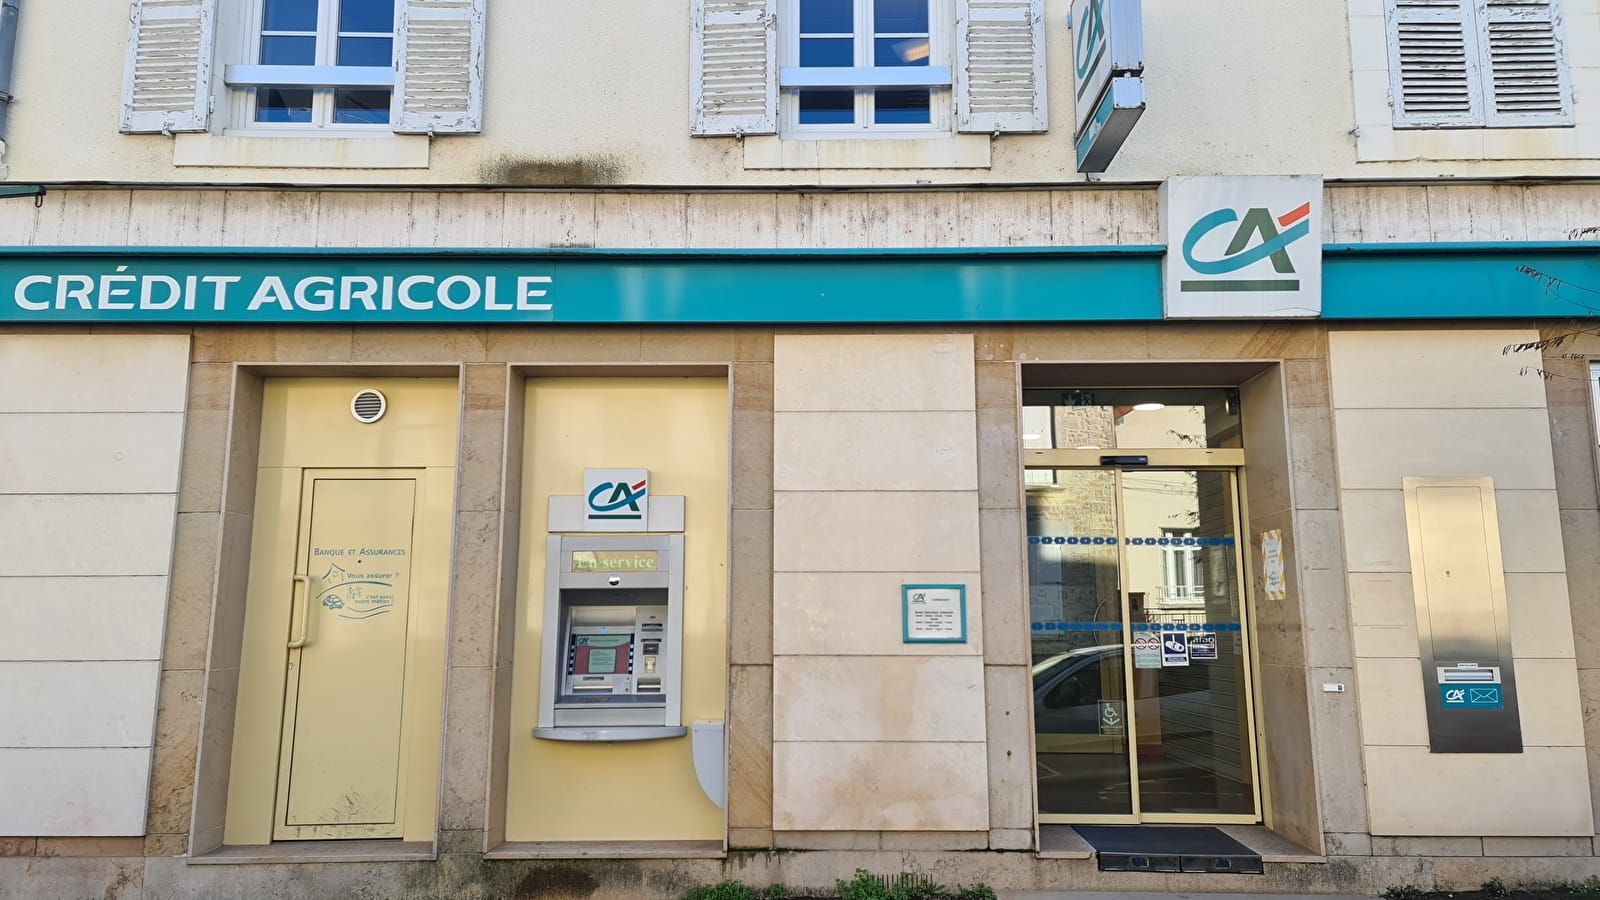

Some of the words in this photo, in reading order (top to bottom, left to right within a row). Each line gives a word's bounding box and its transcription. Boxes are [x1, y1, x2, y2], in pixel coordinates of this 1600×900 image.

[1181, 201, 1310, 275] CA
[14, 265, 241, 310] CRÉDIT
[246, 275, 553, 311] AGRICOLE
[588, 480, 646, 512] CA
[314, 548, 344, 556] BANQUE
[360, 548, 405, 556] ASSURANCES
[602, 555, 654, 568] service
[1446, 689, 1465, 701] CA
